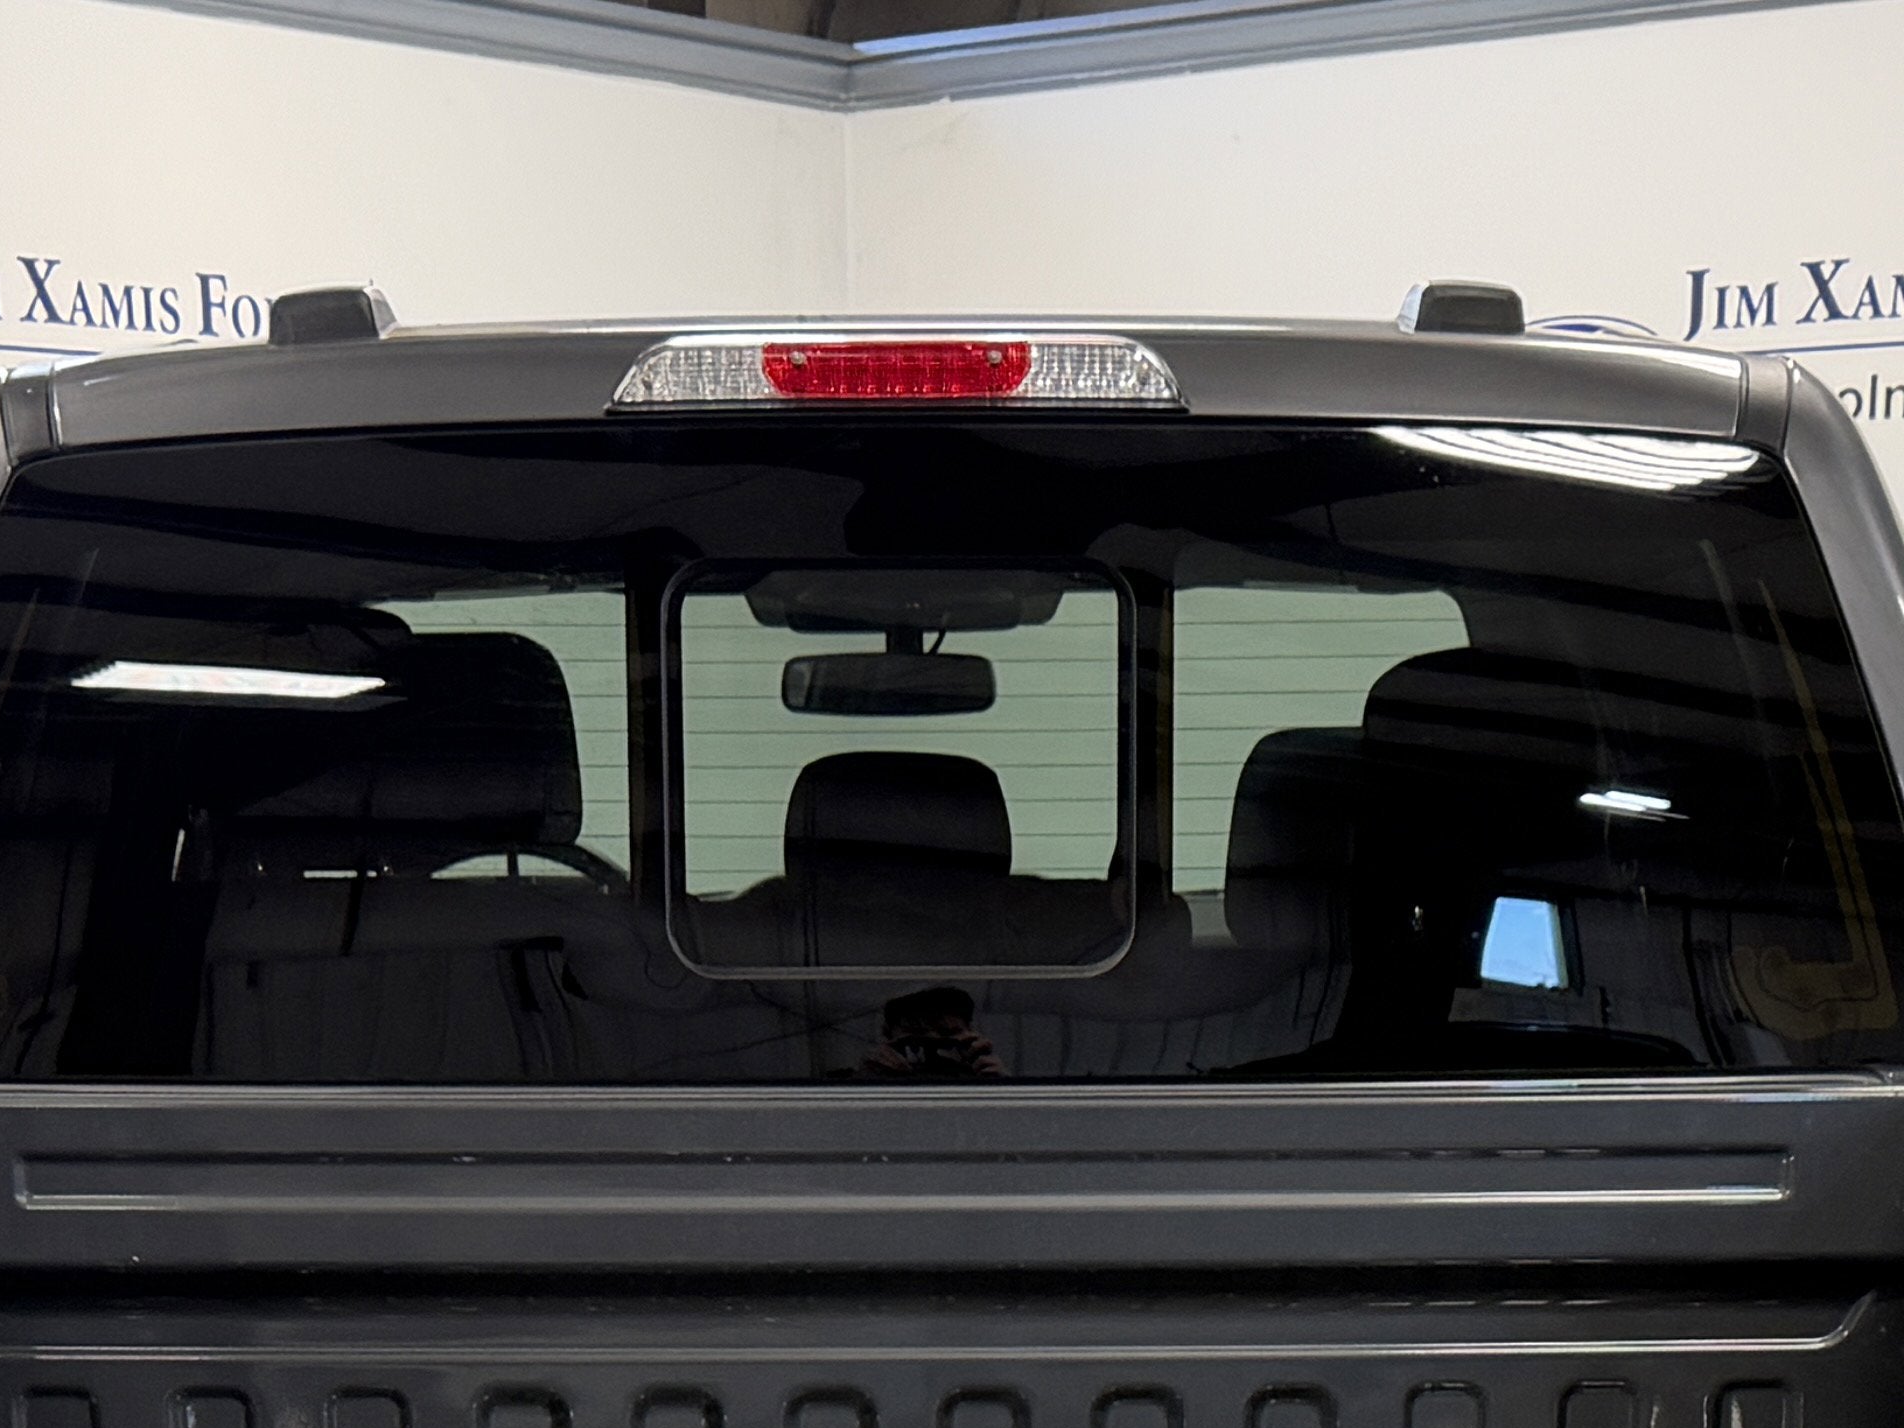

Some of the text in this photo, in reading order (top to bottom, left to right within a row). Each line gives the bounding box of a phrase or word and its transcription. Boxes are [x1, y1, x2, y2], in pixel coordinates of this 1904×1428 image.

[16, 256, 182, 335] XAMIS
[194, 271, 275, 339] FO
[1683, 267, 1779, 342] JIM
